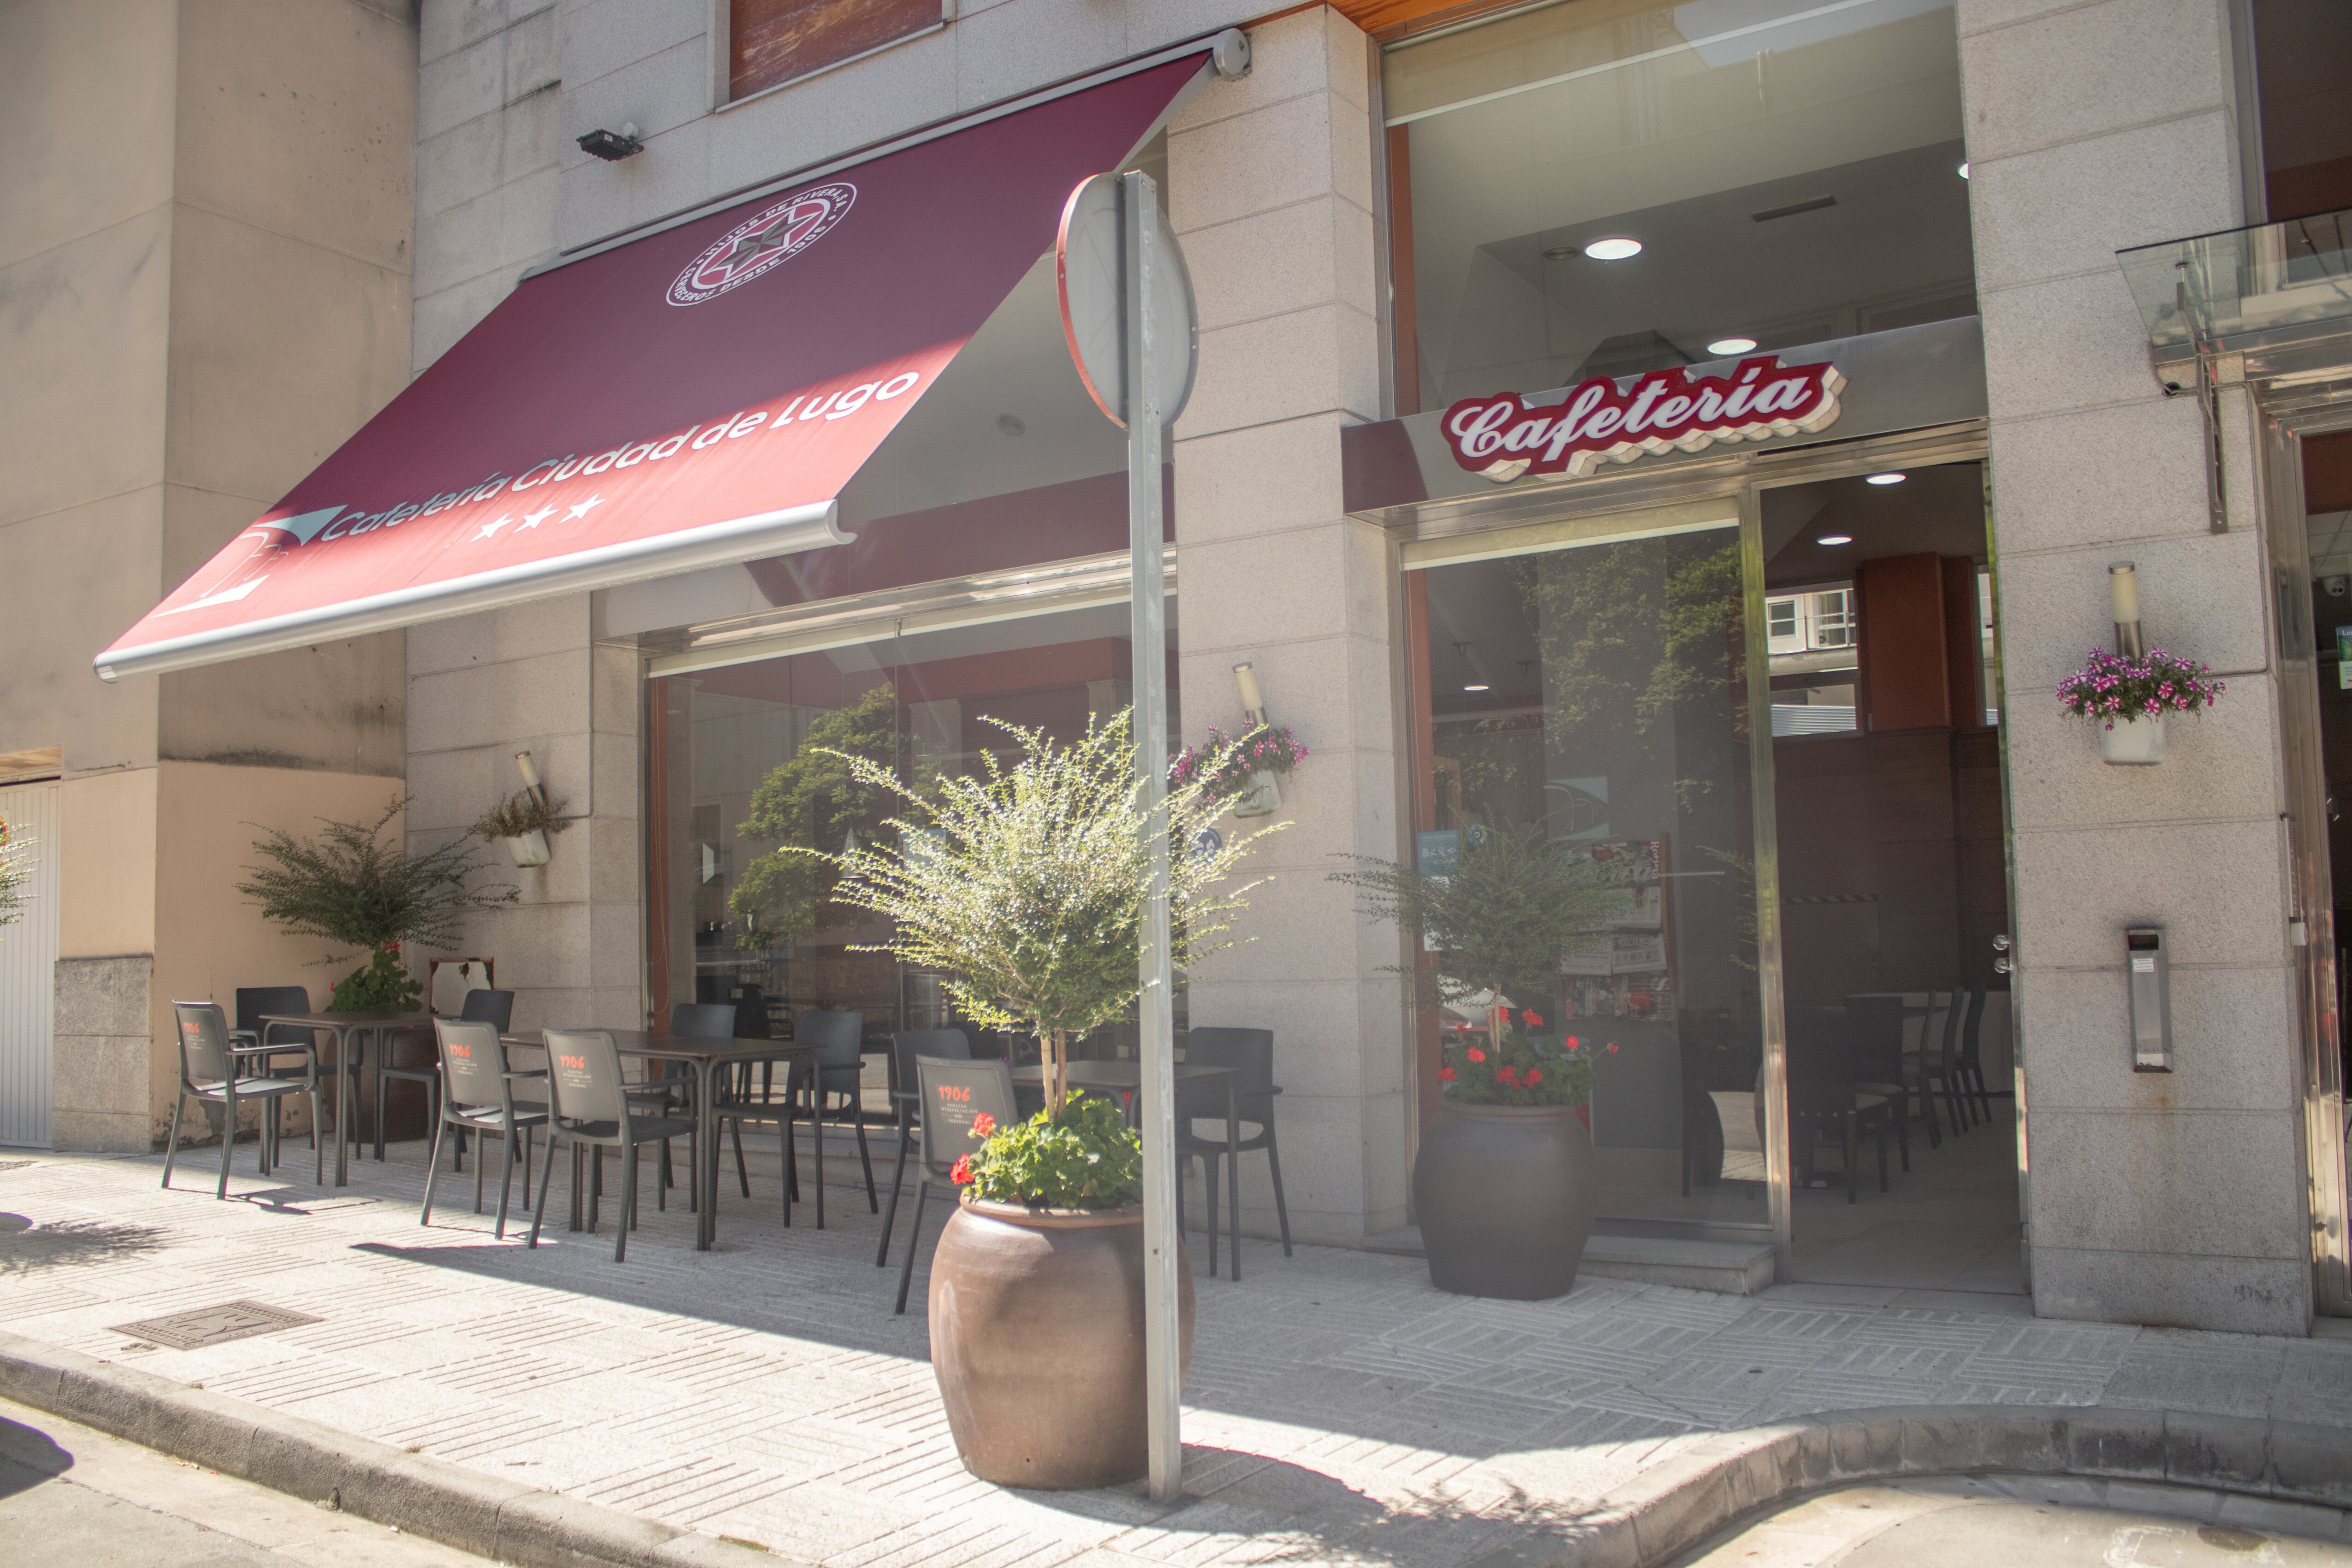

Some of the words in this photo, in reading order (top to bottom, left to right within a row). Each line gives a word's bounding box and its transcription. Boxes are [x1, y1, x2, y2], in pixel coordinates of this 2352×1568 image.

[705, 219, 759, 255] HIJOS
[766, 203, 788, 217] DE
[675, 267, 716, 301] CERVECEROS
[719, 258, 780, 292] DESDE
[321, 469, 512, 541] Cafetería
[511, 424, 701, 492] Ciudad
[691, 411, 768, 450] de
[769, 372, 920, 430] Lugo
[449, 1044, 471, 1057] 1906
[559, 1055, 585, 1069] 1906
[938, 1086, 970, 1102] 1906
